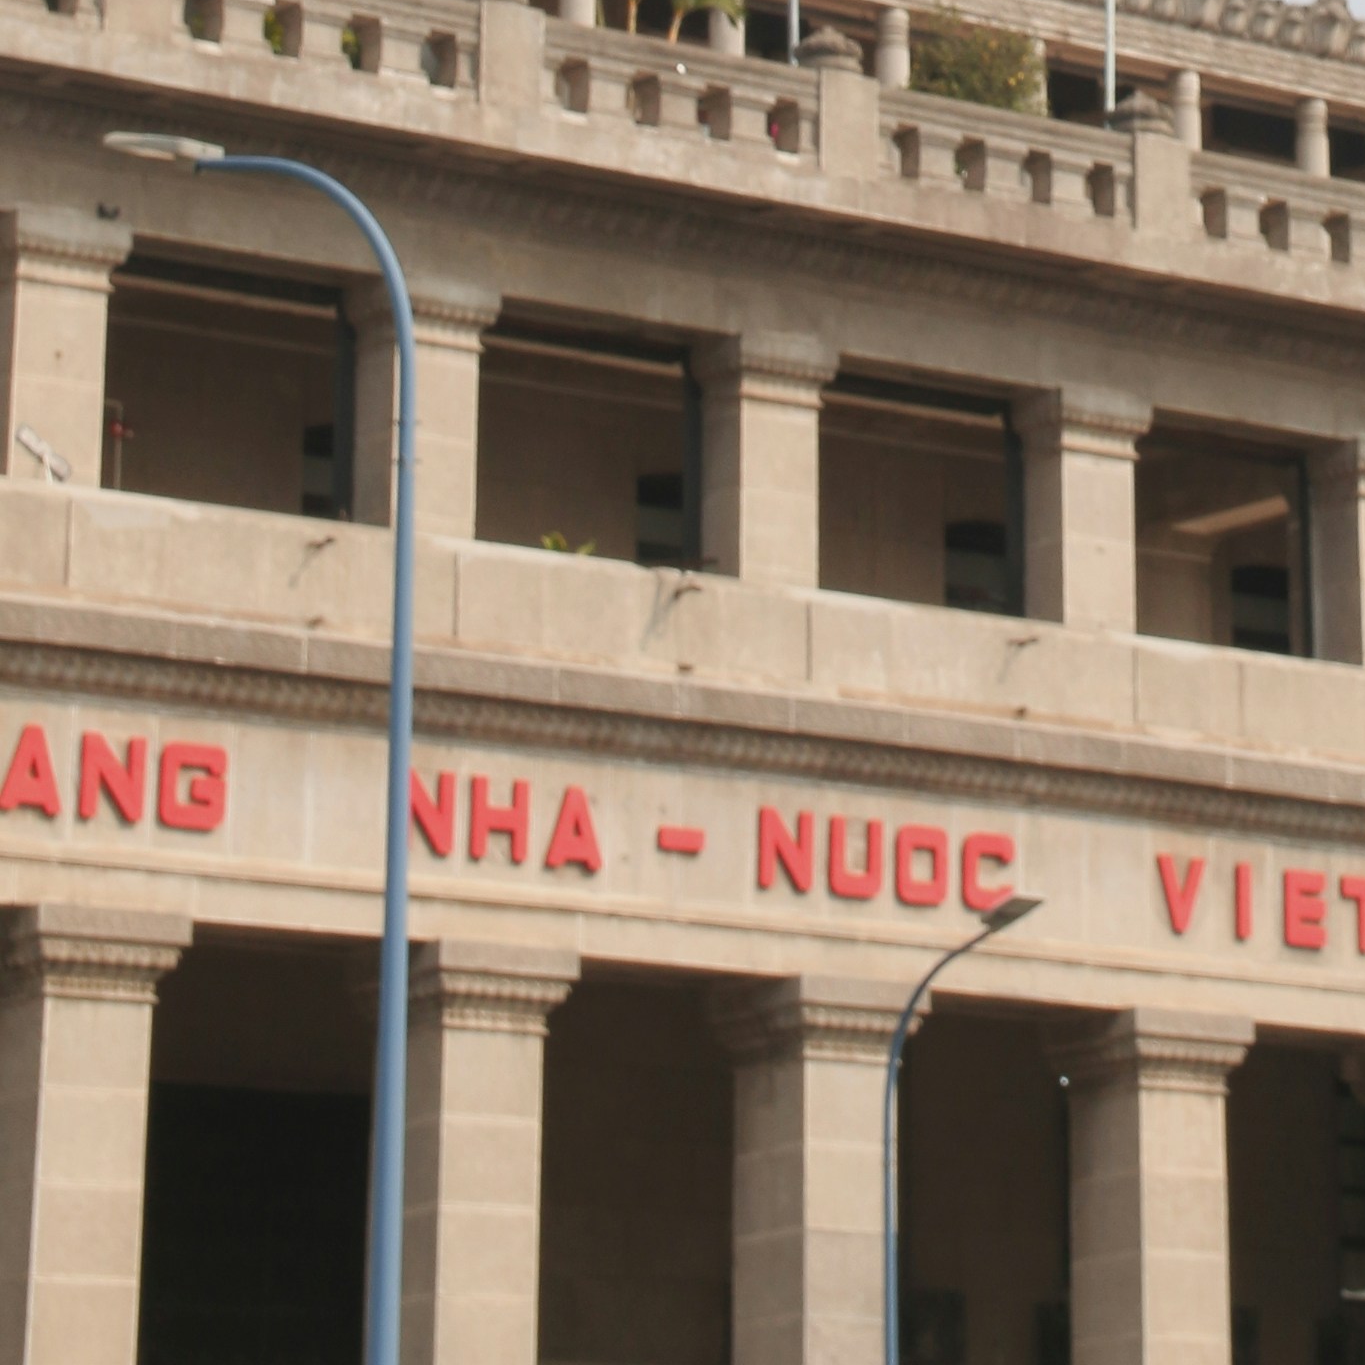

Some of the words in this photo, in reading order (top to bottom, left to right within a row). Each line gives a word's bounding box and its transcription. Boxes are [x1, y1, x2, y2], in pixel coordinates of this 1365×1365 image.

[0, 722, 229, 832] ANG
[408, 768, 604, 873] NHA
[757, 804, 1017, 912] NUOC
